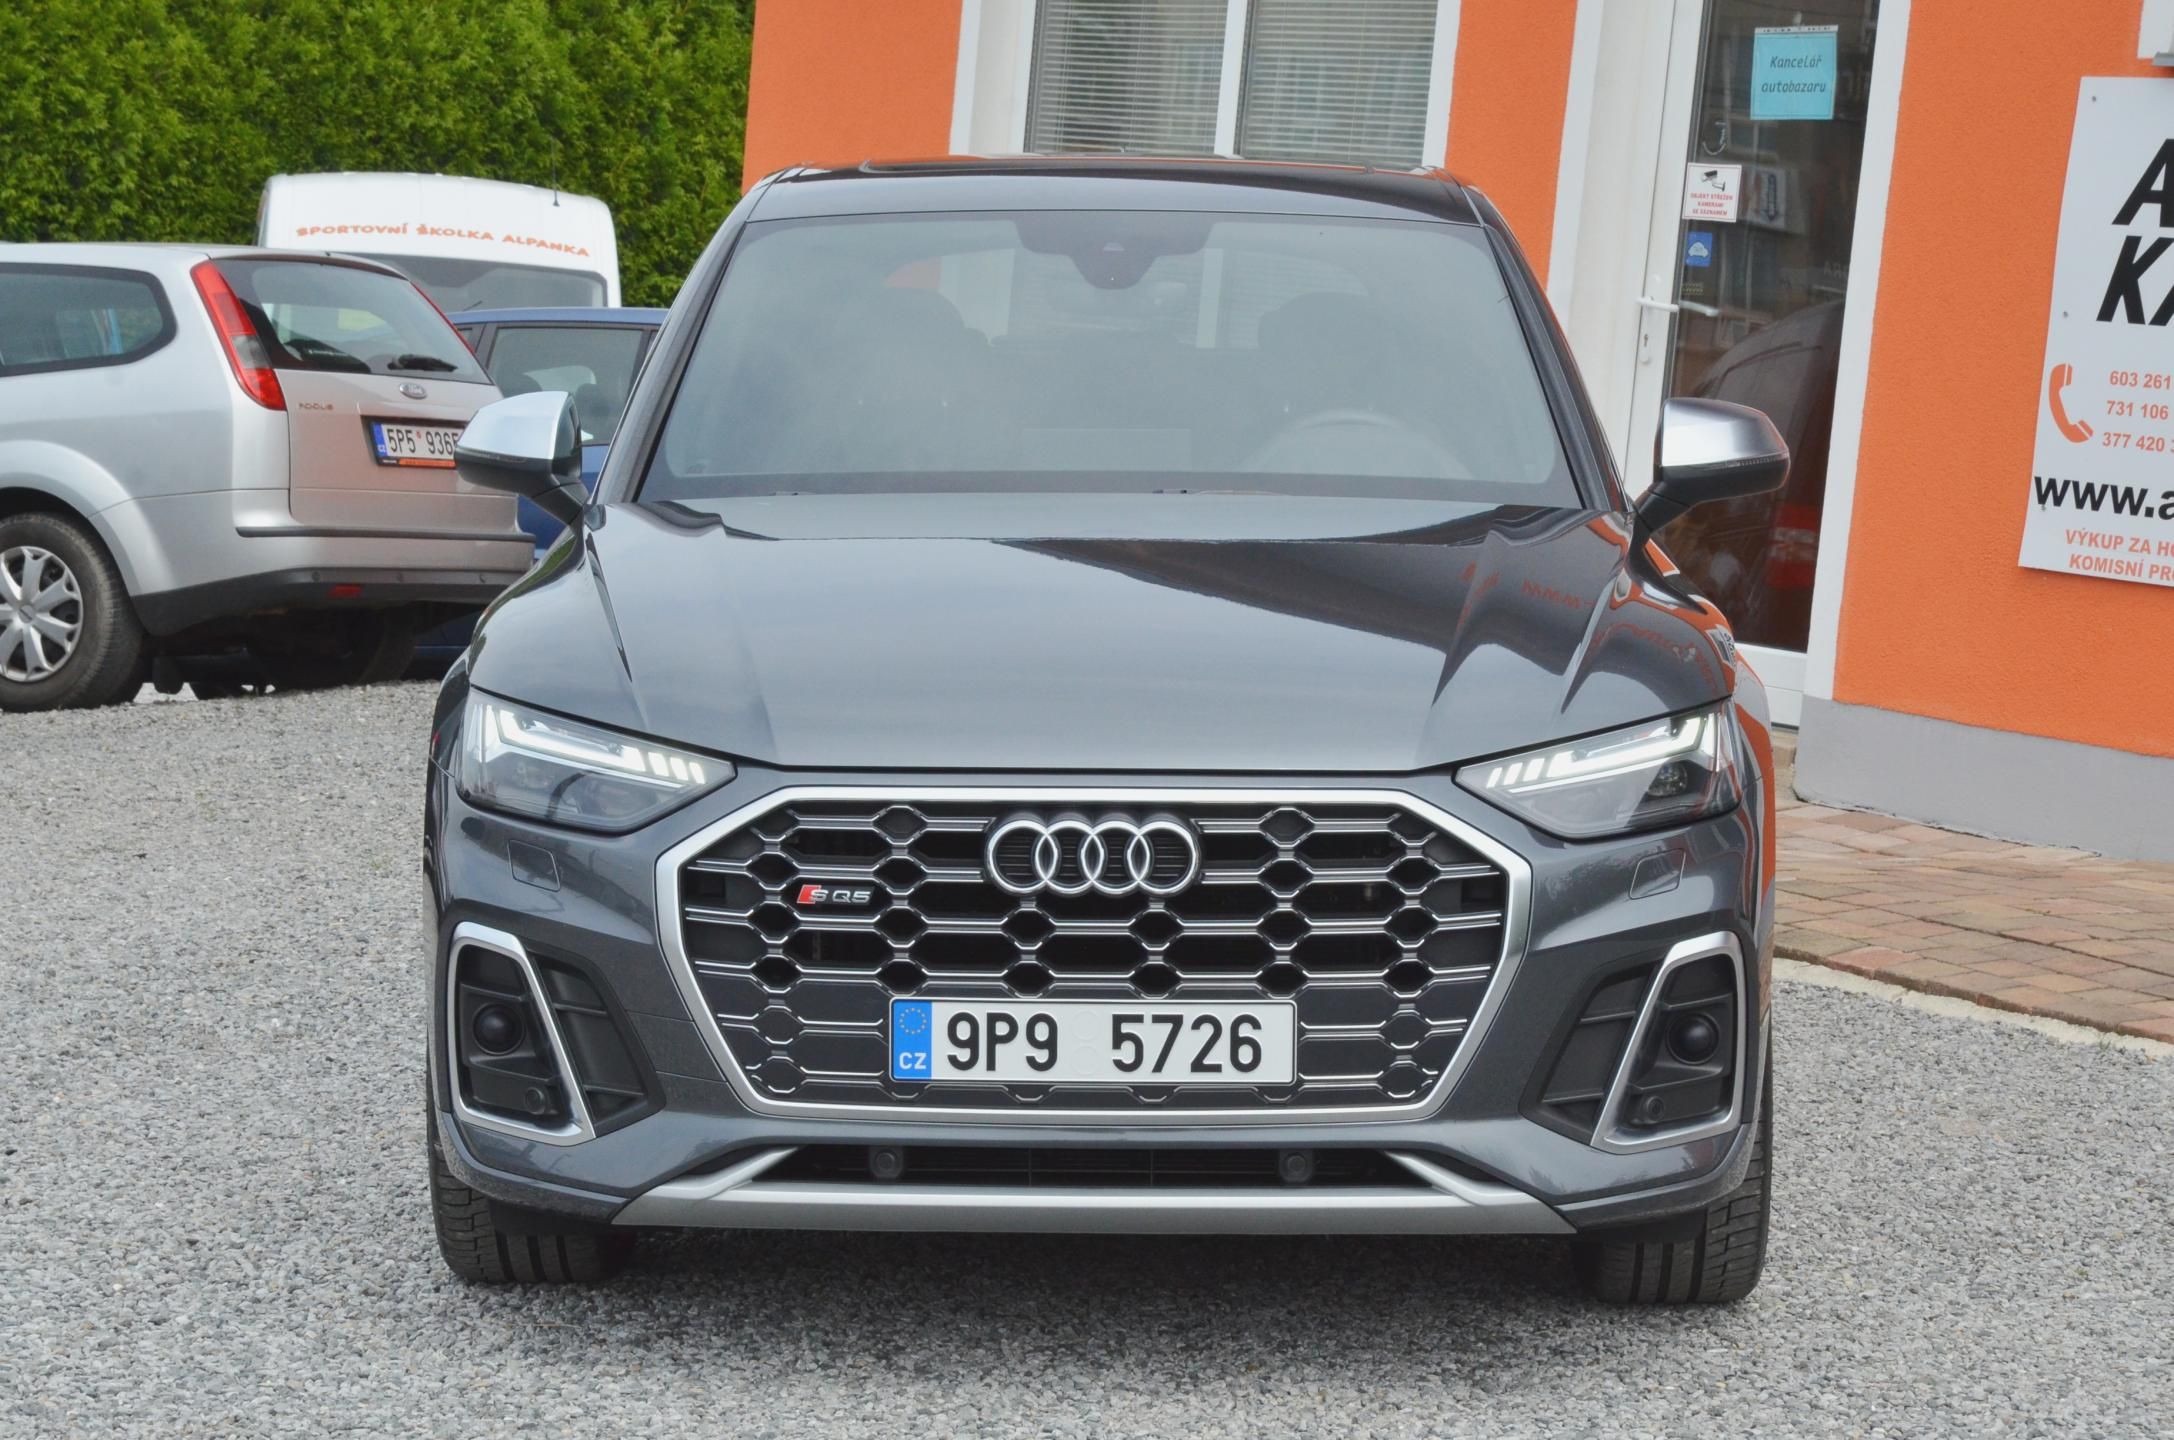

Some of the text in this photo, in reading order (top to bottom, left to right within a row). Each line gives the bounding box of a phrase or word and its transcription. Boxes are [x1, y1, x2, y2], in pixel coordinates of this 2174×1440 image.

[1769, 54, 1823, 69] Kancelář
[1761, 79, 1827, 93] autobazaru
[296, 222, 590, 257] SPORTOVNÍ ŠKOLKA ALPANKA
[2096, 235, 2174, 327] K
[2109, 370, 2172, 390] 603 261
[2106, 400, 2169, 420] 731 106
[386, 428, 416, 454] 5P5
[2102, 432, 2131, 449] 377
[2135, 435, 2165, 452] 420
[2065, 527, 2124, 550] VÝKUP
[2128, 537, 2151, 555] ZA
[2069, 553, 2174, 581] KOMISNÍ PR
[946, 1011, 1263, 1073] 9P9 5726
[899, 1051, 927, 1070] CZ
